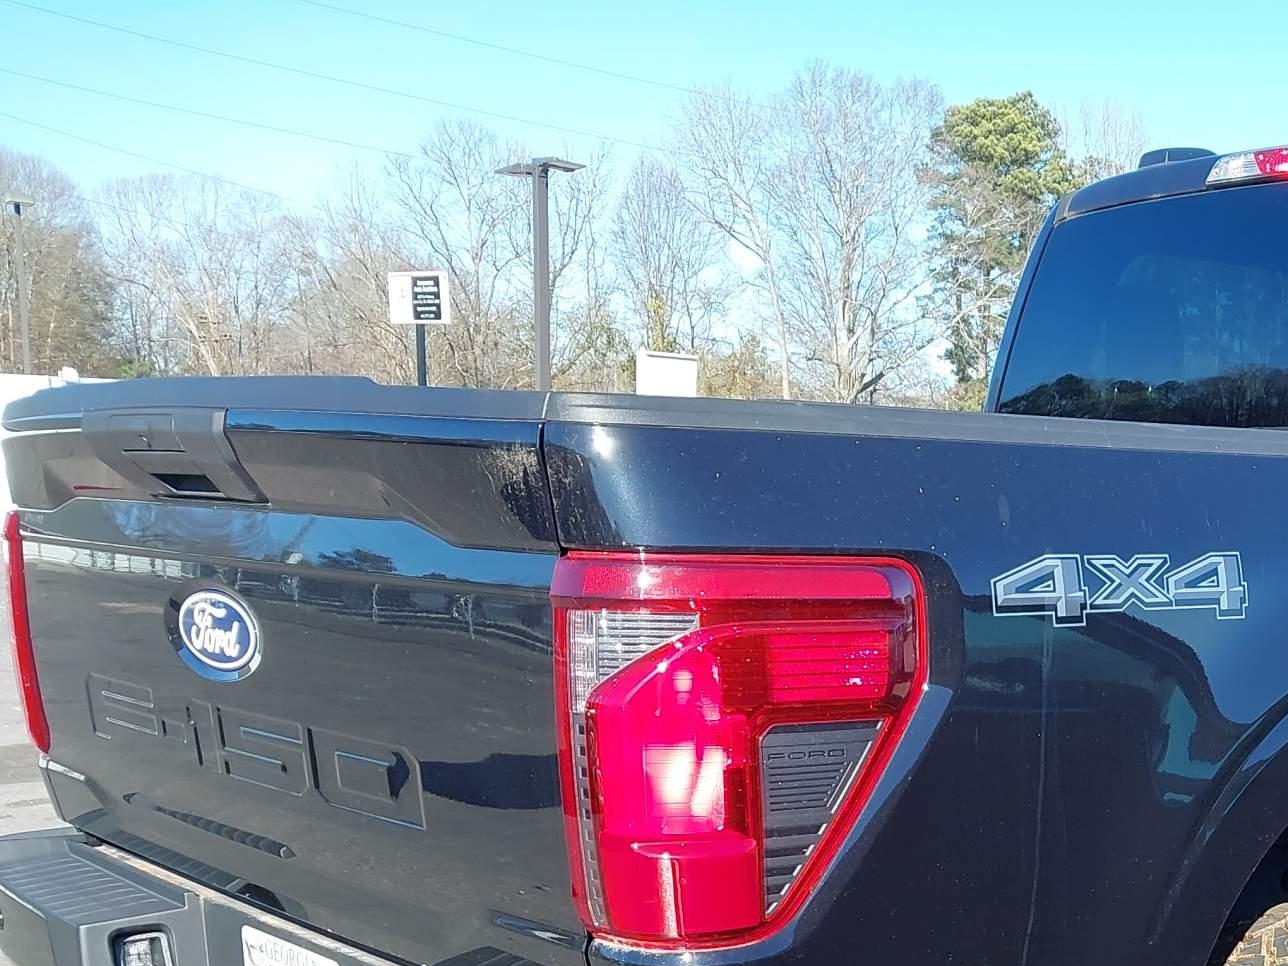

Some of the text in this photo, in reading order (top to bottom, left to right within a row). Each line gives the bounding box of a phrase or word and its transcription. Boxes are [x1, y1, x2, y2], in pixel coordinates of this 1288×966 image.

[990, 552, 1249, 628] 4X4
[190, 601, 240, 658] Ford
[85, 671, 427, 832] F-150
[768, 749, 847, 761] FORD
